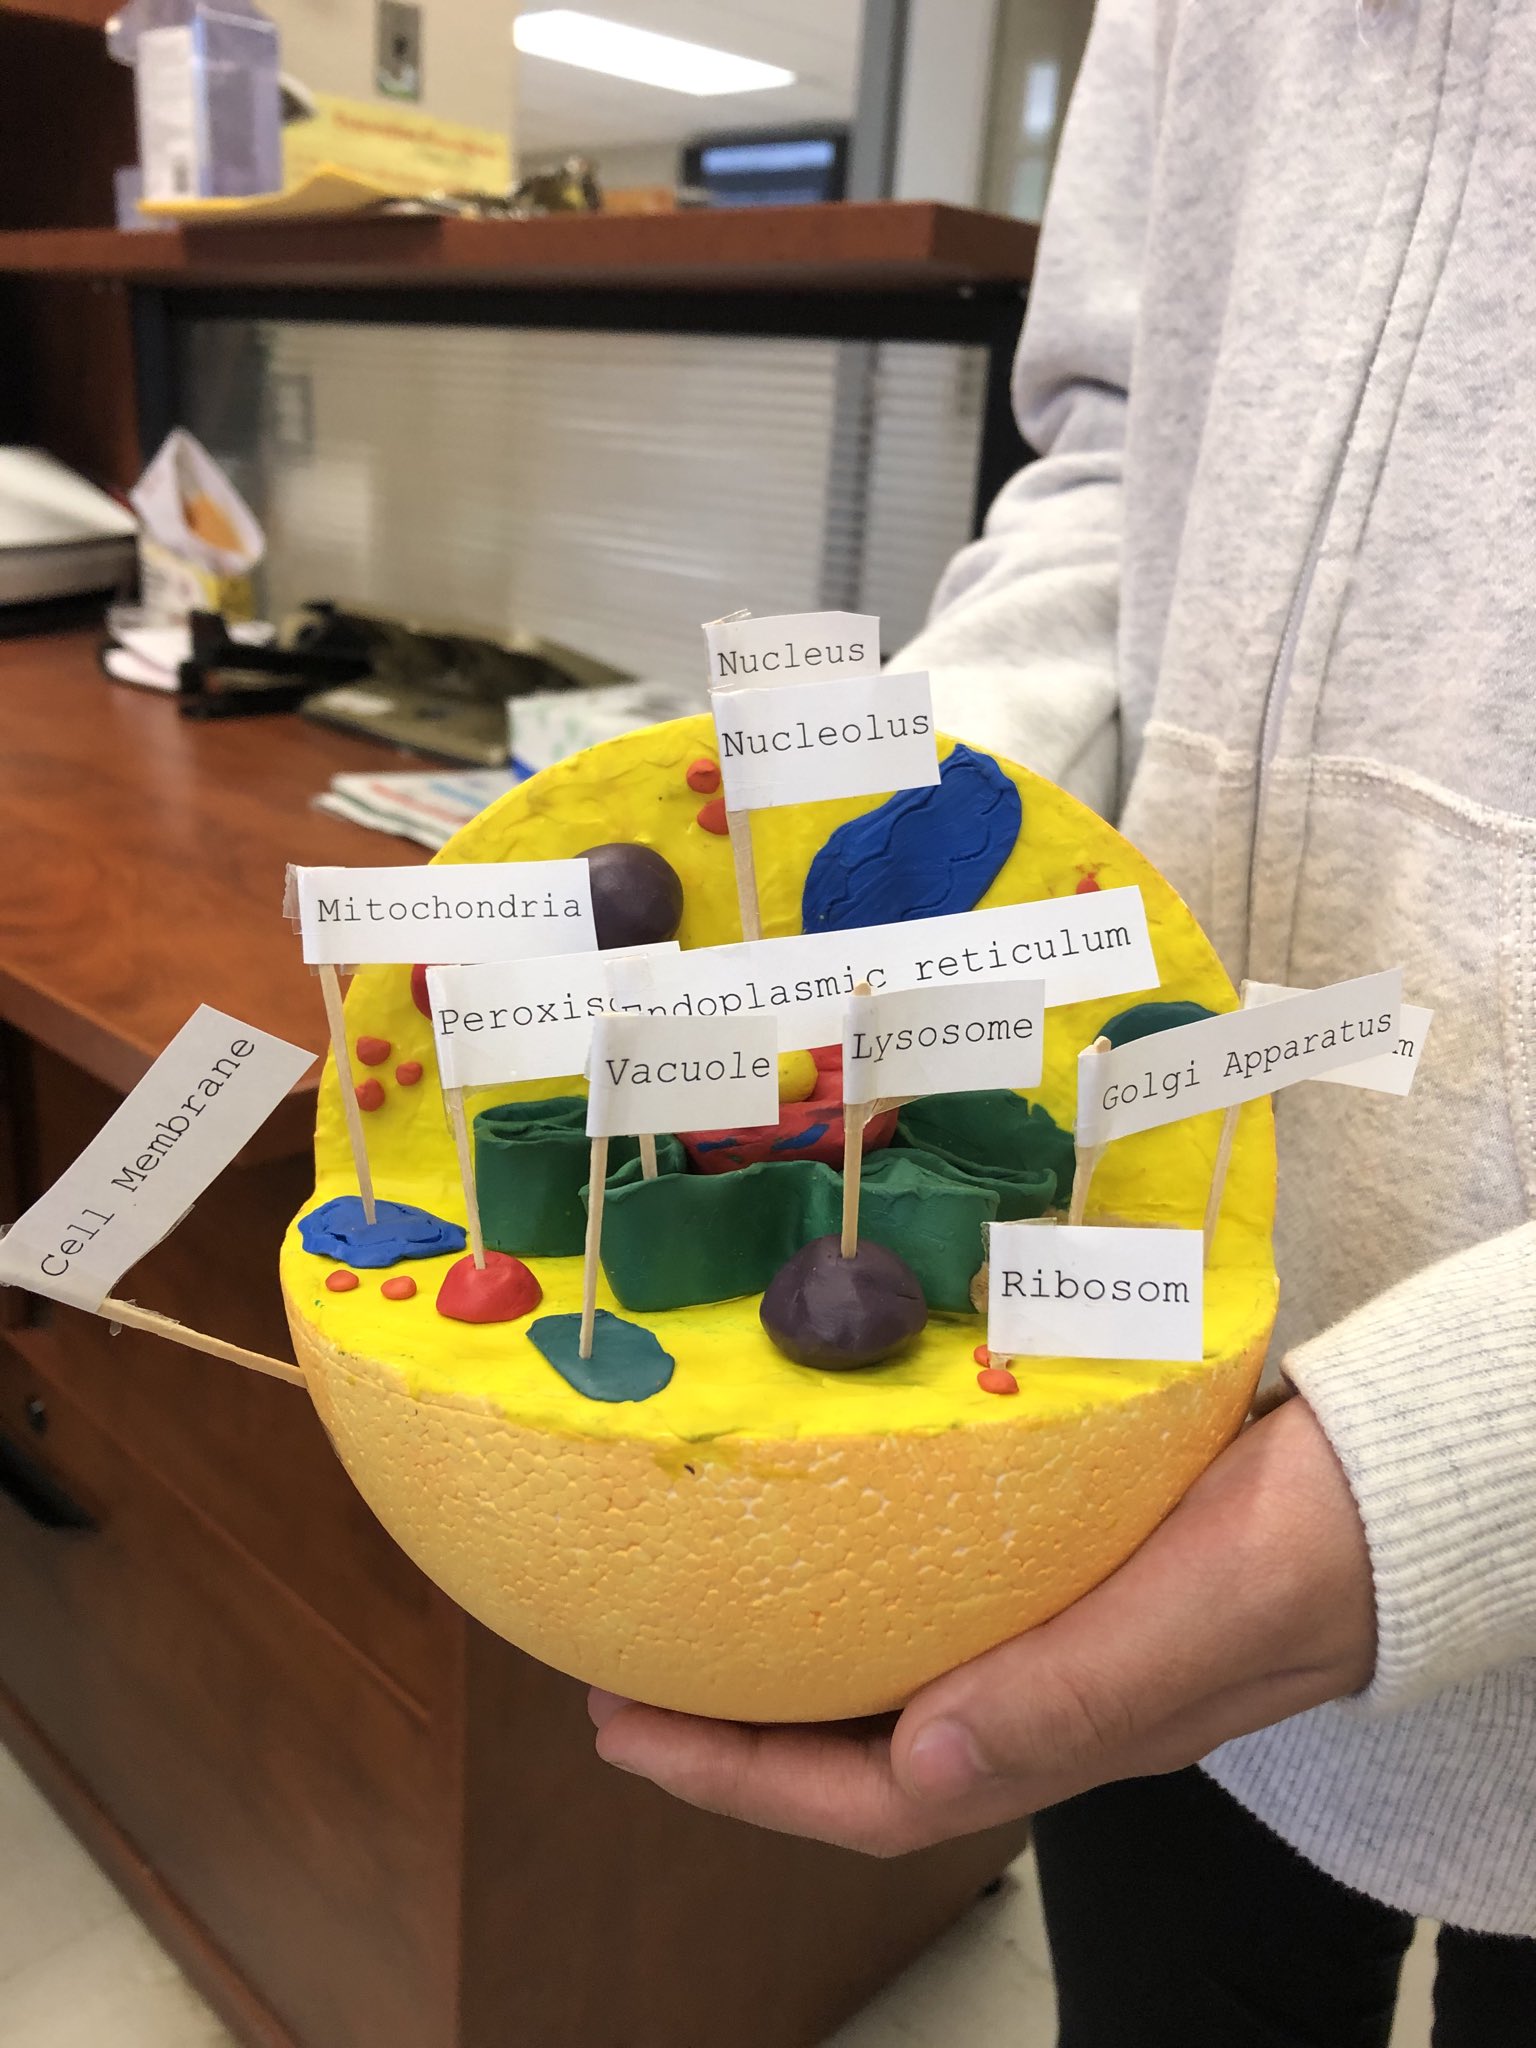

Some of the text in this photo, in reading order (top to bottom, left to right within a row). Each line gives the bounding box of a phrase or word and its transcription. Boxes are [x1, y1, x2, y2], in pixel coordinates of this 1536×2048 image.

[717, 643, 865, 676] Nucleus
[721, 714, 929, 757] Nucleolus
[317, 893, 582, 922] Mitochondria
[621, 926, 1131, 1016] ndoplasmic reticulum
[438, 993, 616, 1035] Peroxis
[851, 1017, 1033, 1062] Lysosome
[605, 1051, 770, 1086] Vacuole
[1101, 1012, 1392, 1111] Golgi Apparatus
[40, 1038, 255, 1277] Cell Membrane
[1001, 1269, 1190, 1303] Ribosom
